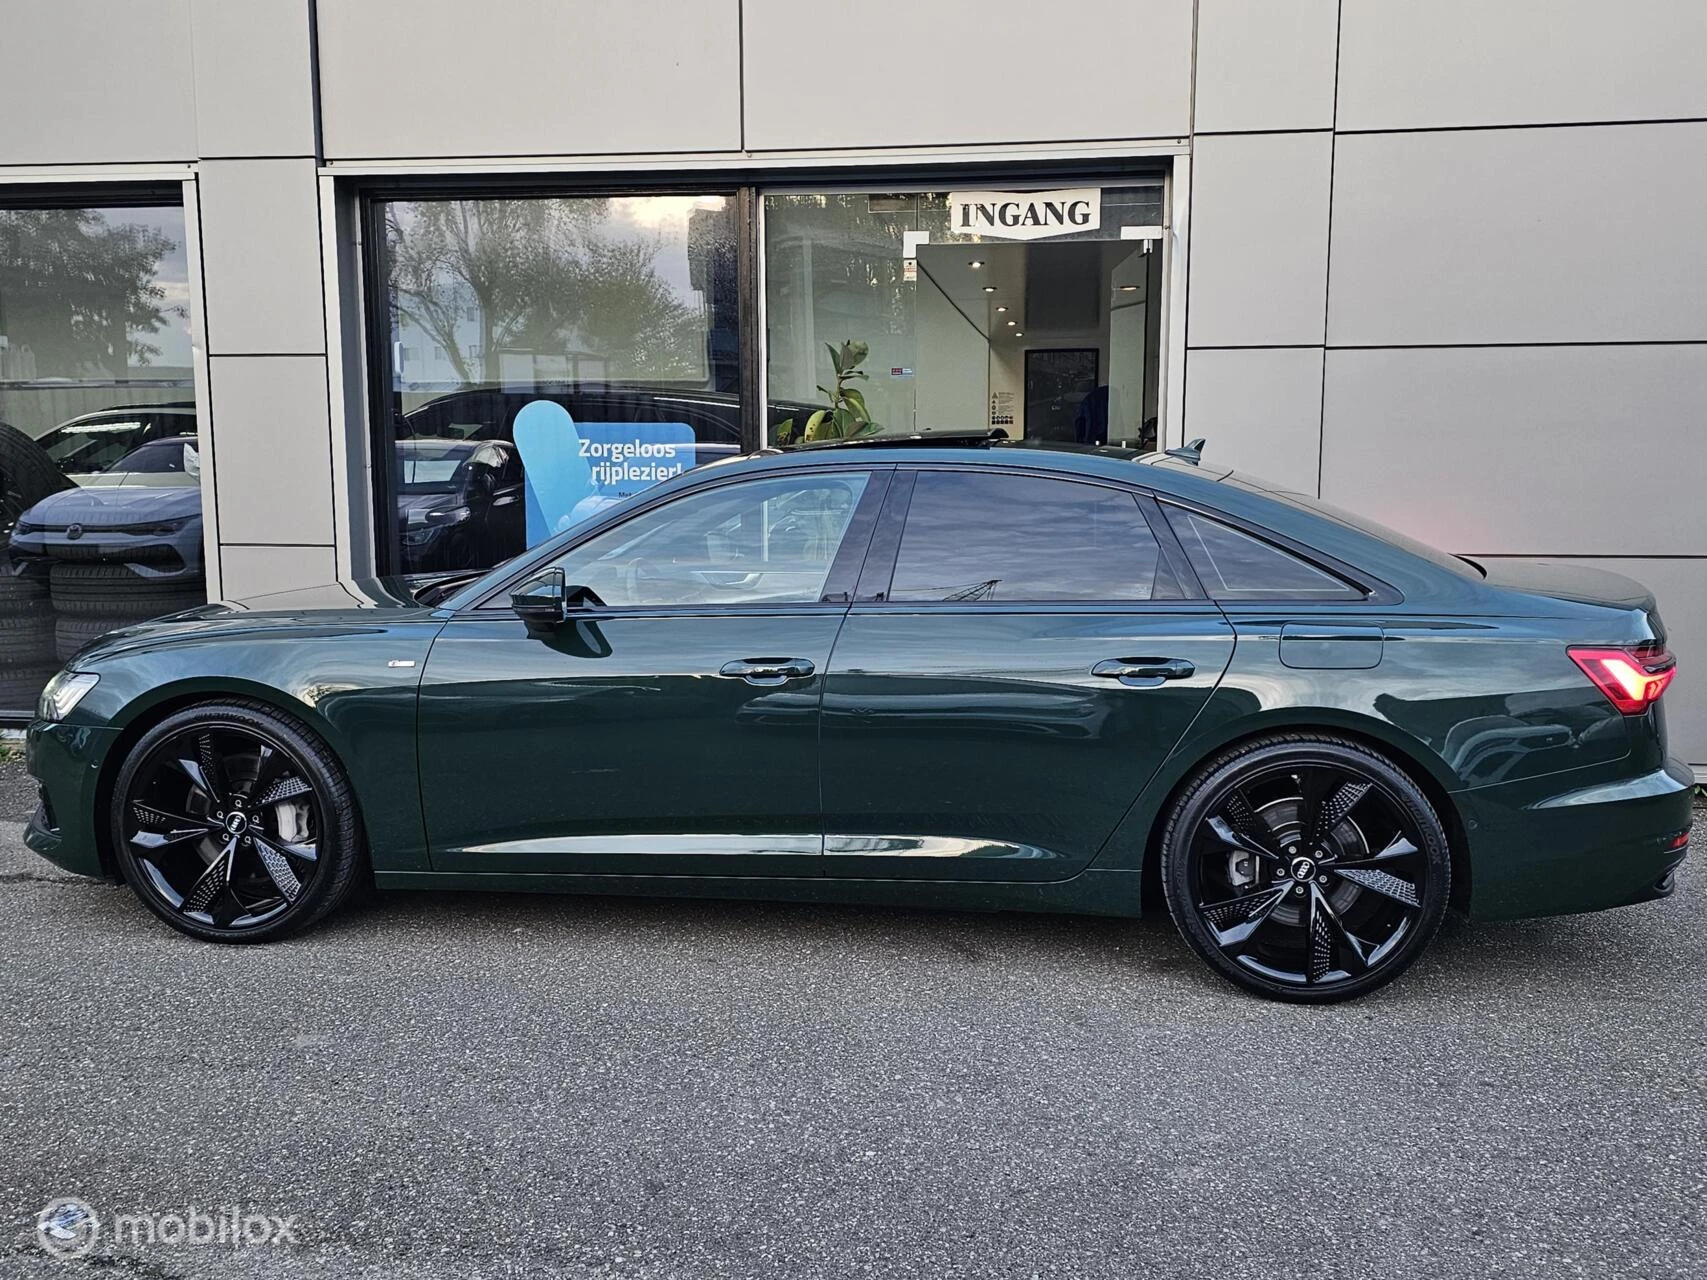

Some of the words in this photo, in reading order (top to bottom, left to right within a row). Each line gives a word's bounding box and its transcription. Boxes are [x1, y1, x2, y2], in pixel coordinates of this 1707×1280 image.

[960, 201, 1091, 227] INGANG
[578, 439, 676, 462] Zorgeloos
[591, 462, 682, 485] rijplezier!
